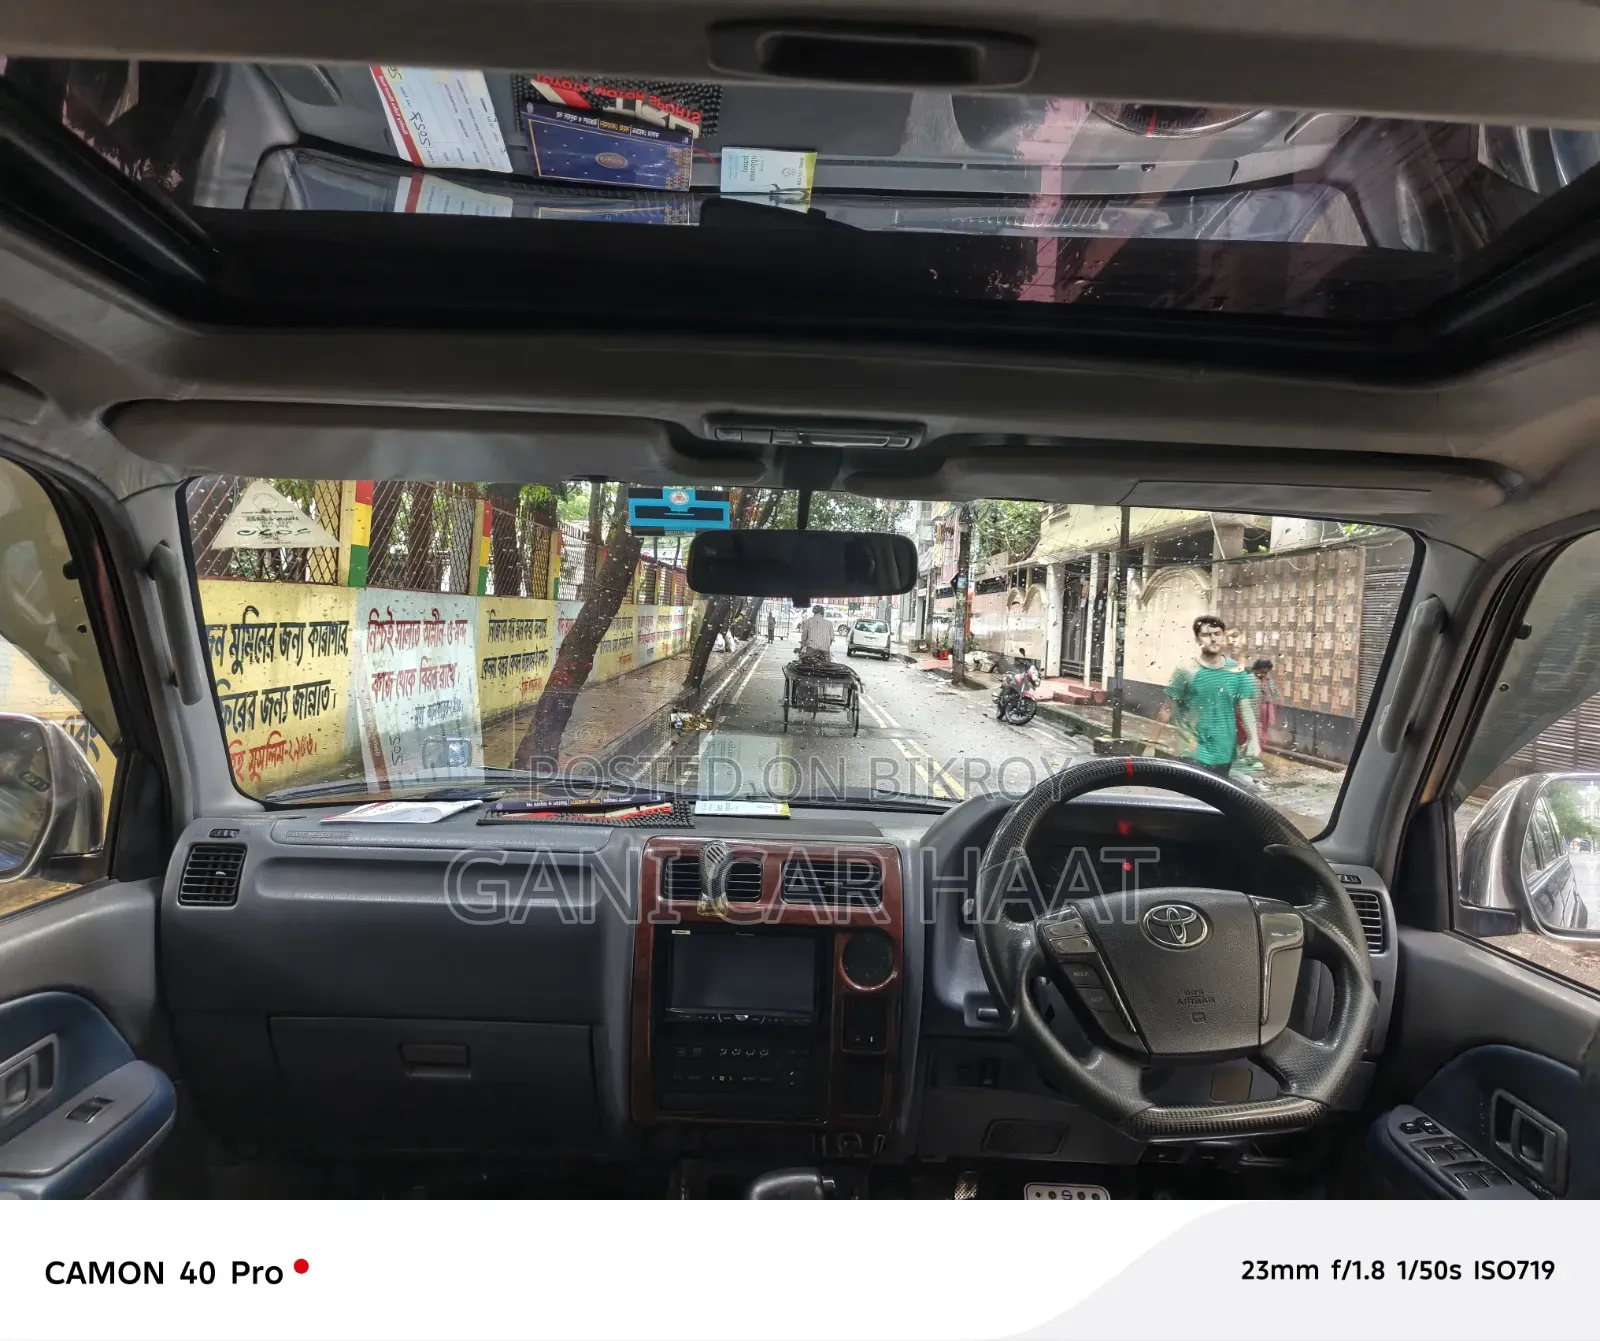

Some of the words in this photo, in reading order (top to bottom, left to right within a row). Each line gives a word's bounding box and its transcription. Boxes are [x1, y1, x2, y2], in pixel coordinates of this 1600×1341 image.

[229, 605, 277, 675] মুমিনের
[279, 622, 306, 667] জন্য
[260, 686, 291, 727] জন্য
